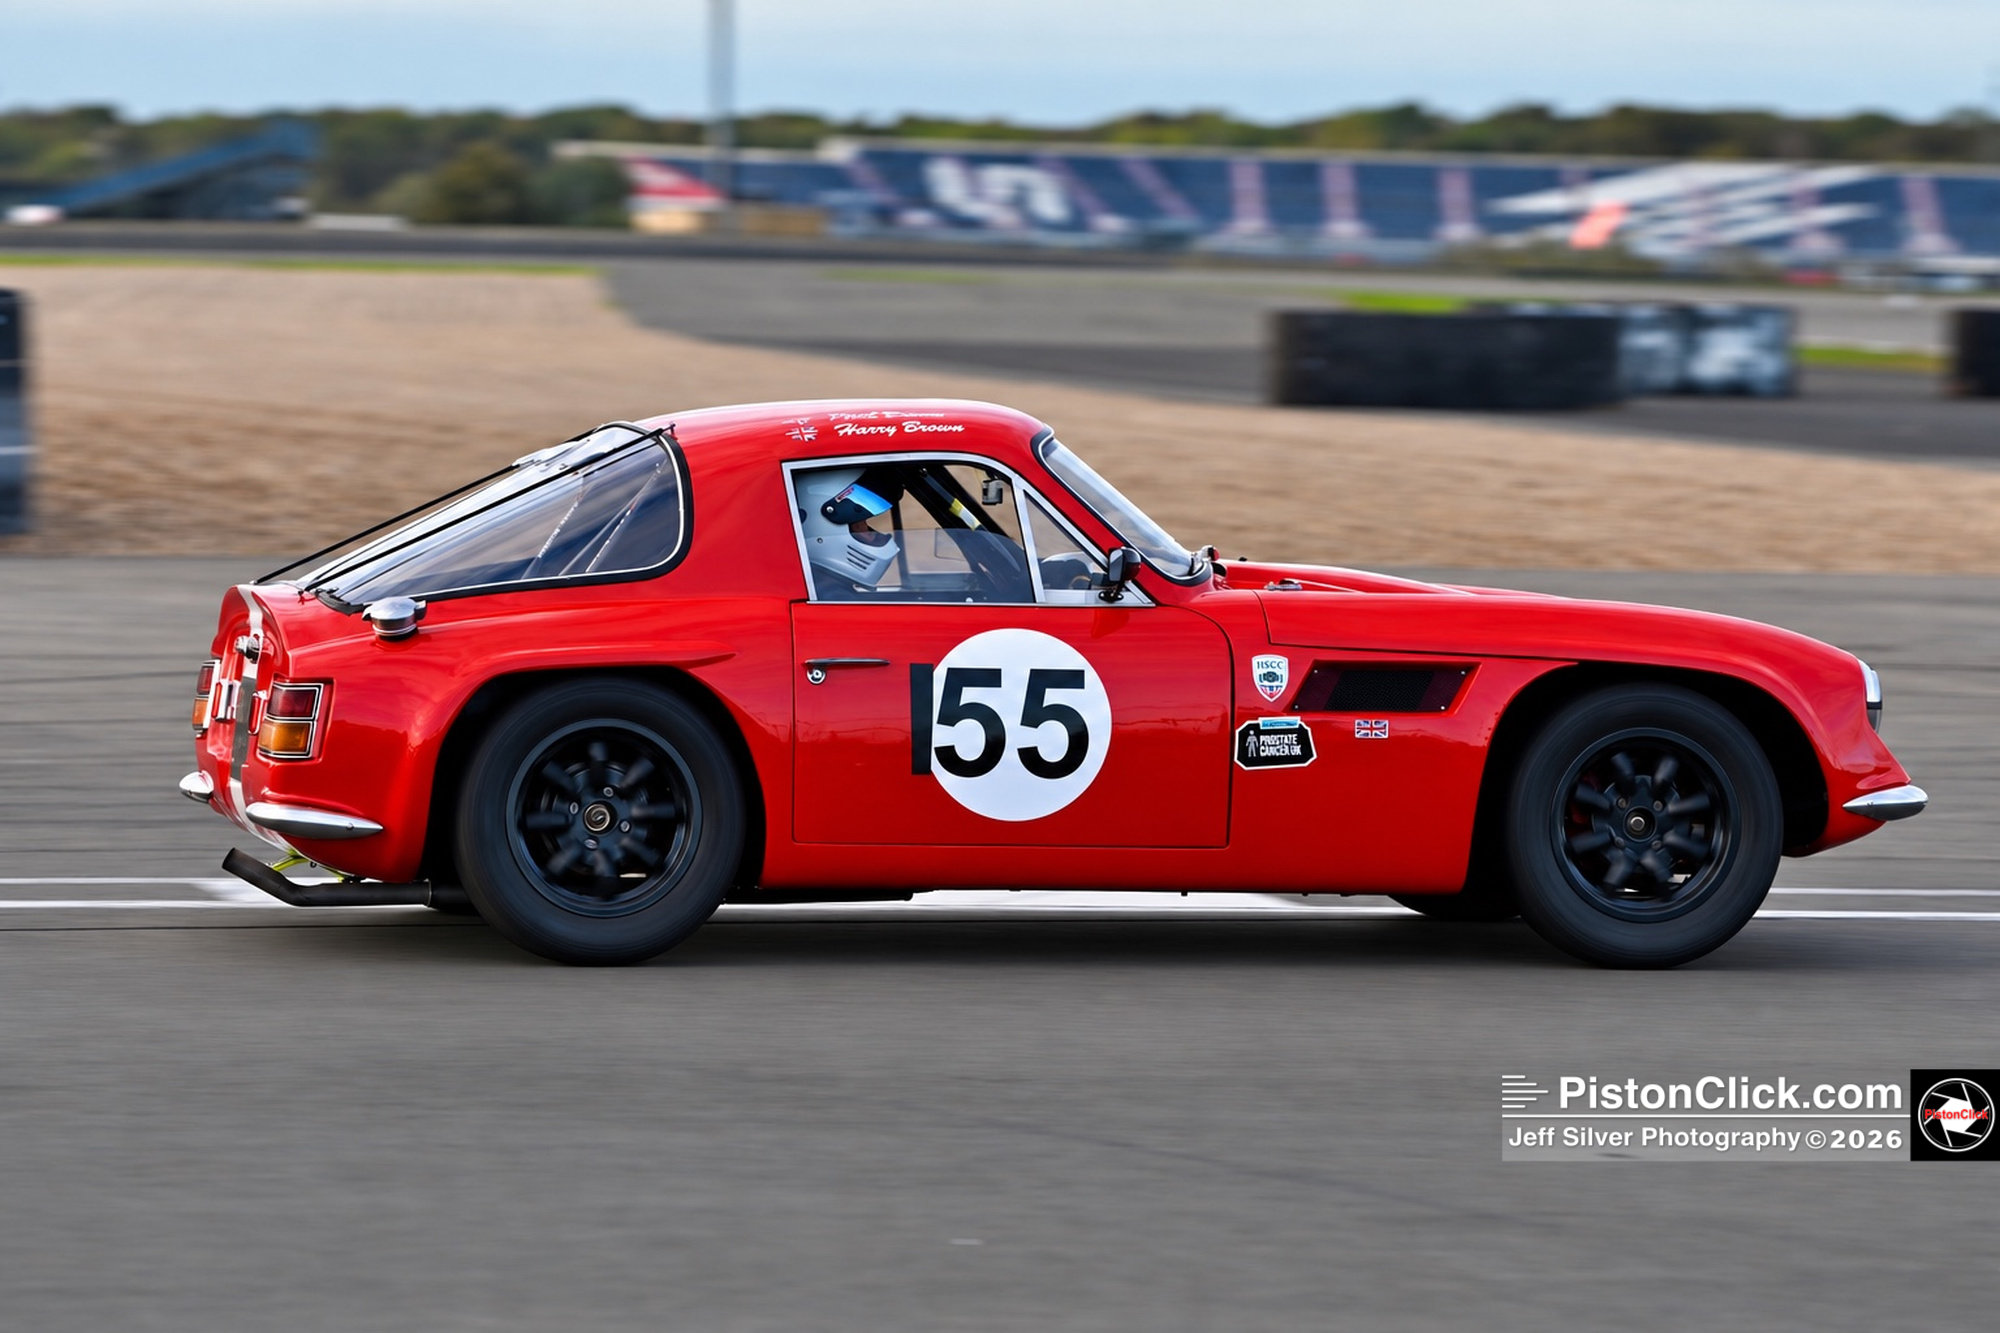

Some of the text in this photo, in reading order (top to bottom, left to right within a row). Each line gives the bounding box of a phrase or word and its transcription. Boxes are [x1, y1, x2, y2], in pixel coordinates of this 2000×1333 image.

[834, 421, 965, 437] Harry Brown
[910, 663, 1089, 780] 155
[1260, 734, 1298, 746] PROSTATE
